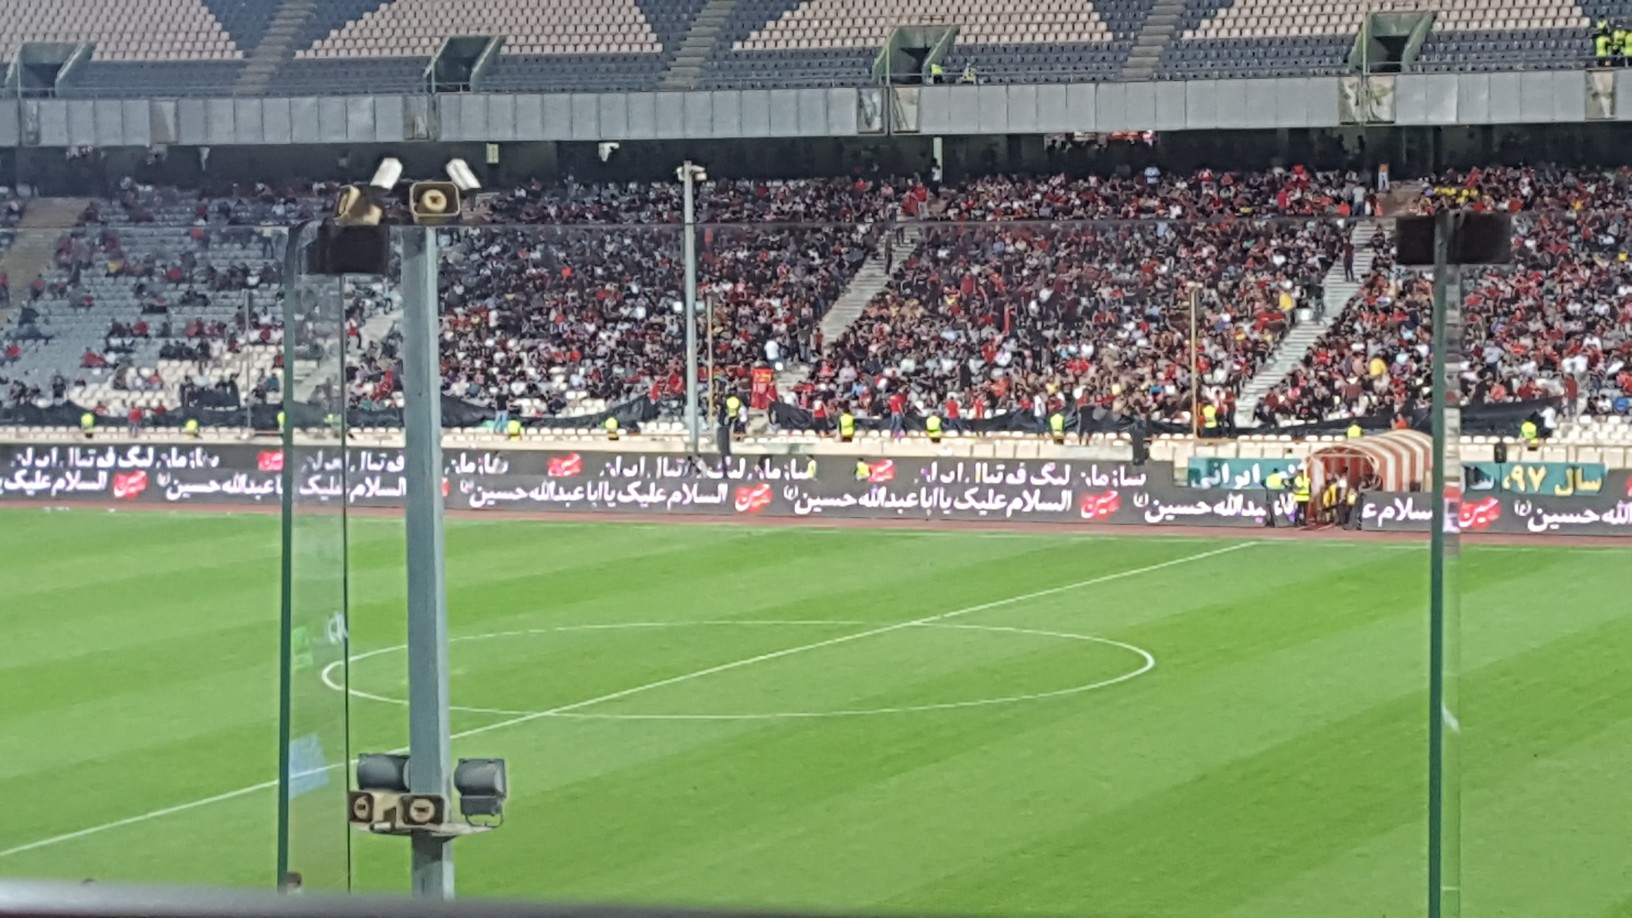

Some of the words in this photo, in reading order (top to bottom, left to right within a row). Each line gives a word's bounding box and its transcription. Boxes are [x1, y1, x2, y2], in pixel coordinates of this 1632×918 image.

[469, 486, 528, 508] حسین
[794, 492, 857, 515] حسین
[1145, 500, 1212, 523] حسین
[1528, 508, 1600, 532] حسین
